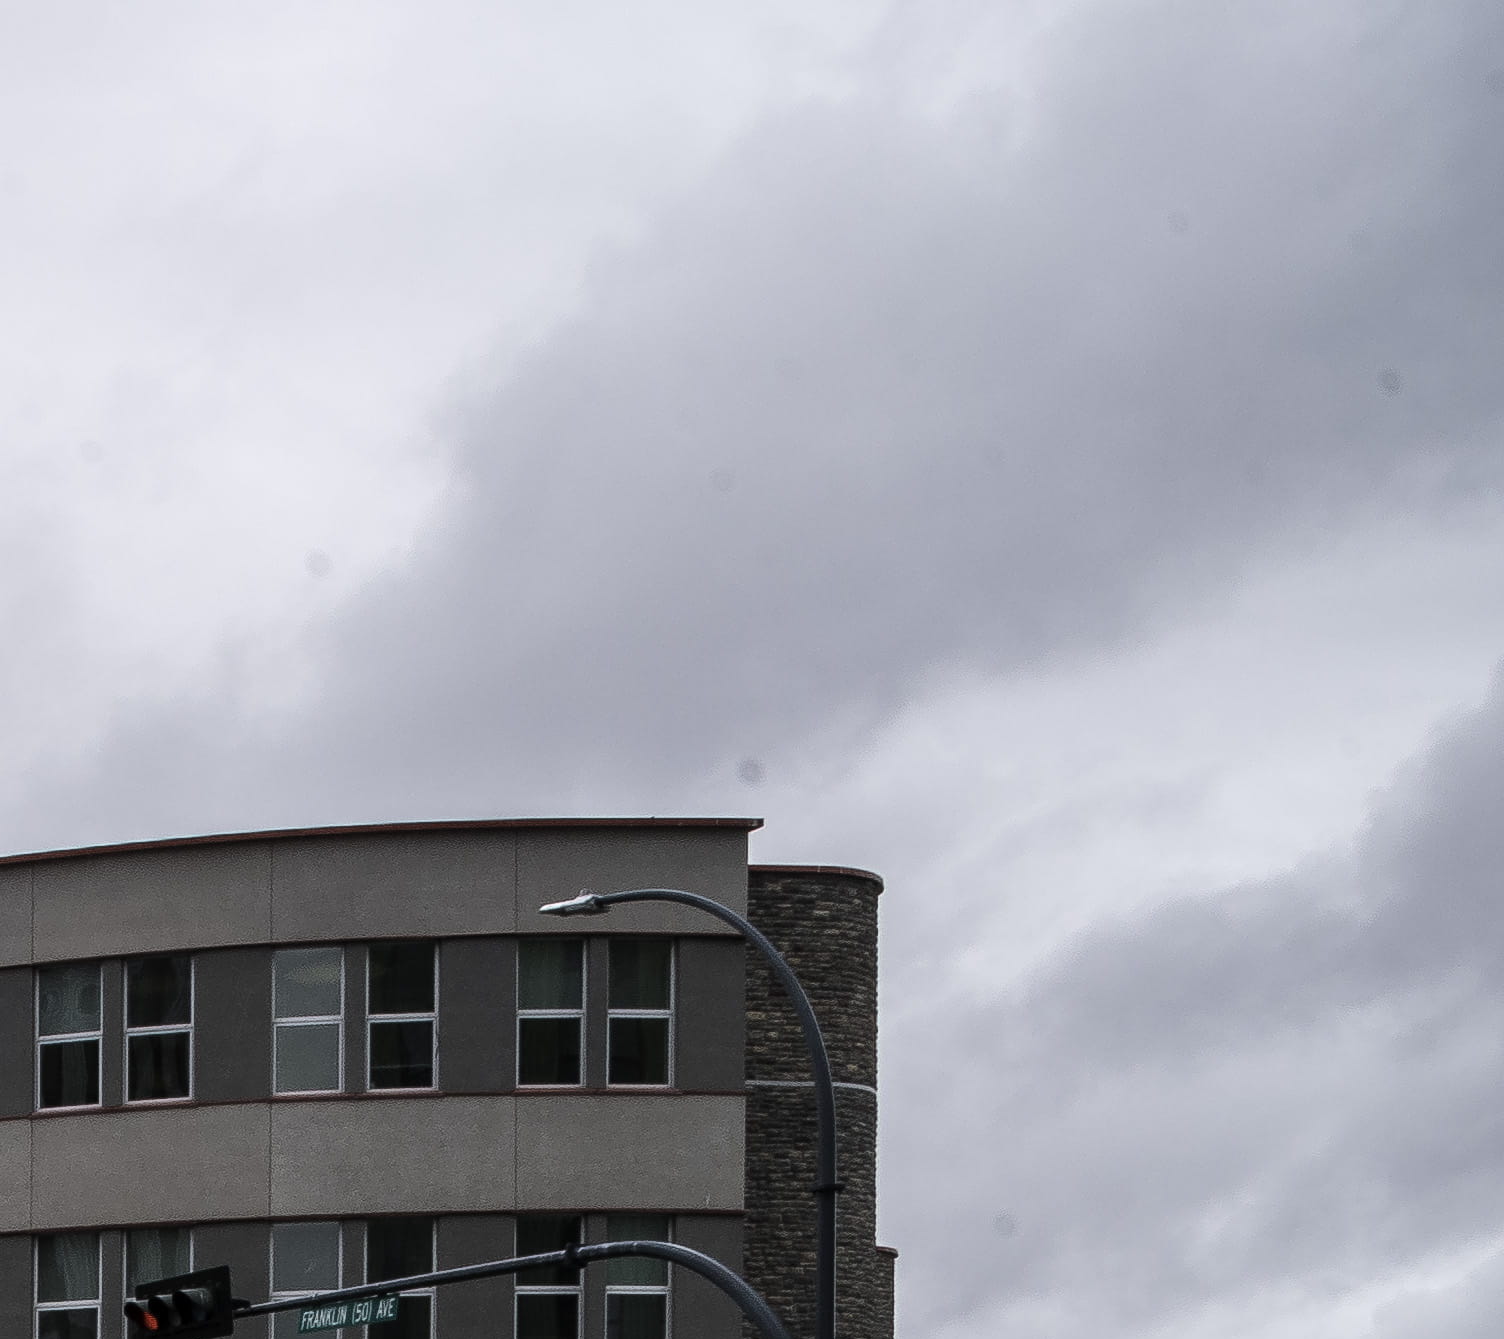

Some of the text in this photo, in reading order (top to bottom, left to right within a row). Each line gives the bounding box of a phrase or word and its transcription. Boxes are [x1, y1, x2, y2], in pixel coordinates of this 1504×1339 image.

[300, 1297, 396, 1331] FRANKLIN (50) AVE
